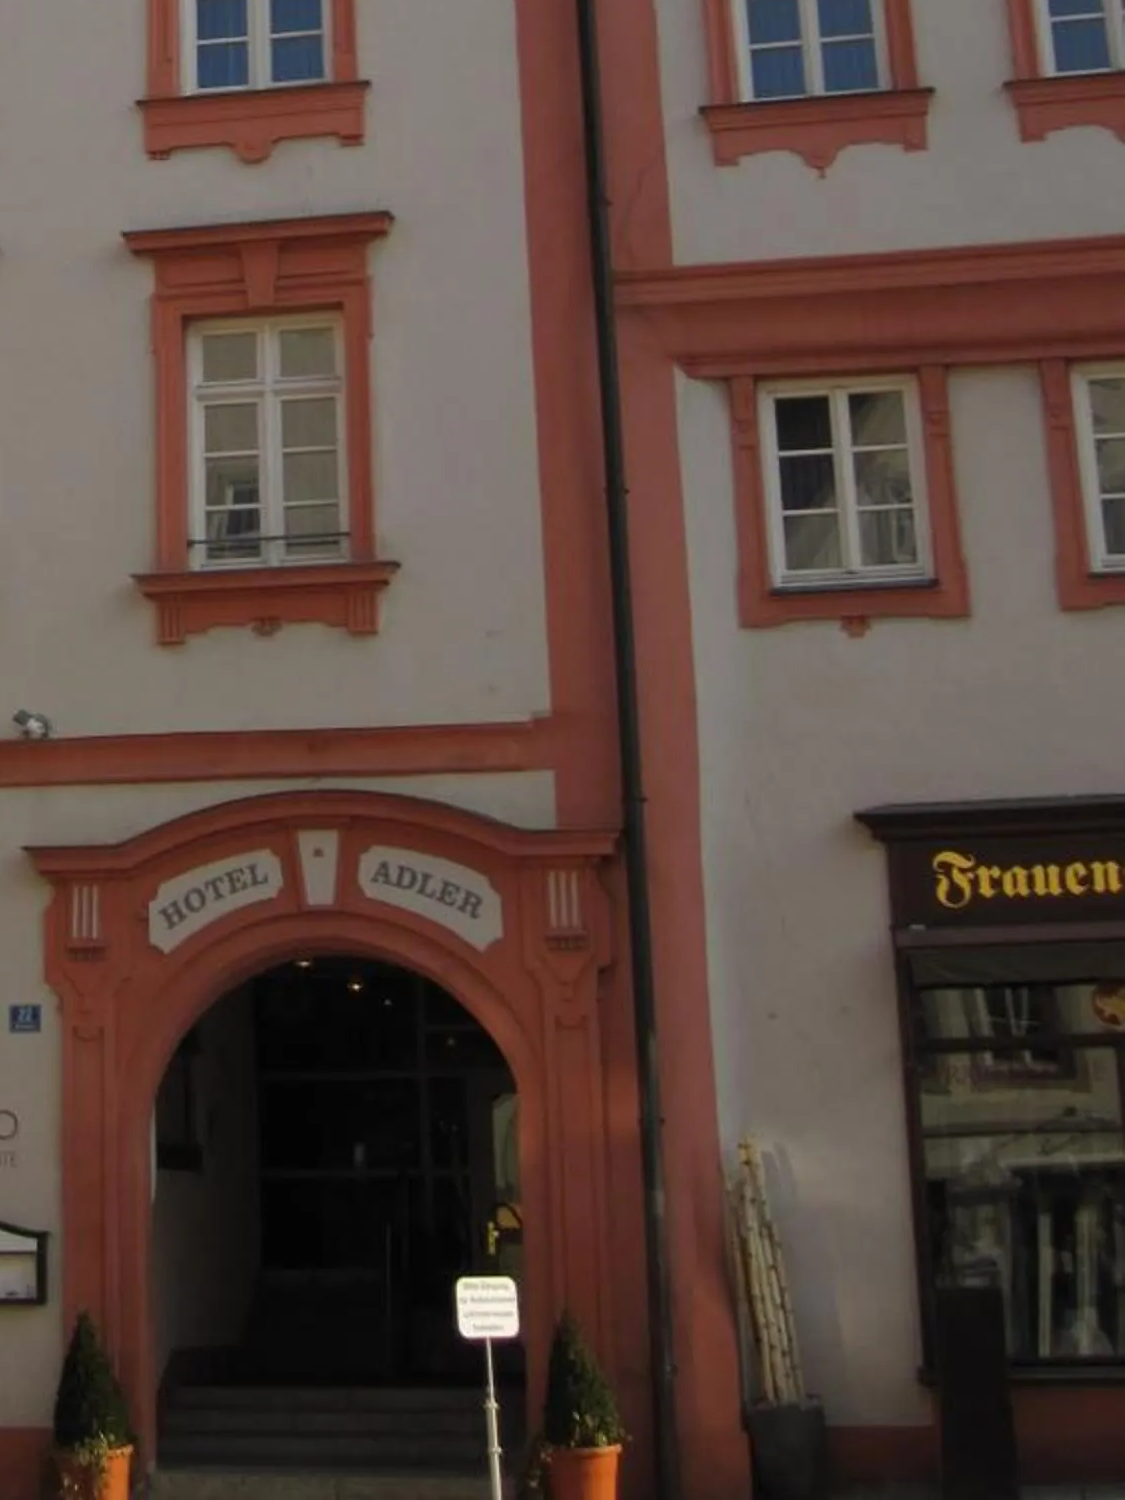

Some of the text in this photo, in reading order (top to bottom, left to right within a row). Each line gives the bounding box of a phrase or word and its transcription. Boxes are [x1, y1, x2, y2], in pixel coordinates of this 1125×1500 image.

[158, 860, 483, 930] HOTEL ADLER
[932, 851, 1123, 909] Frauen
